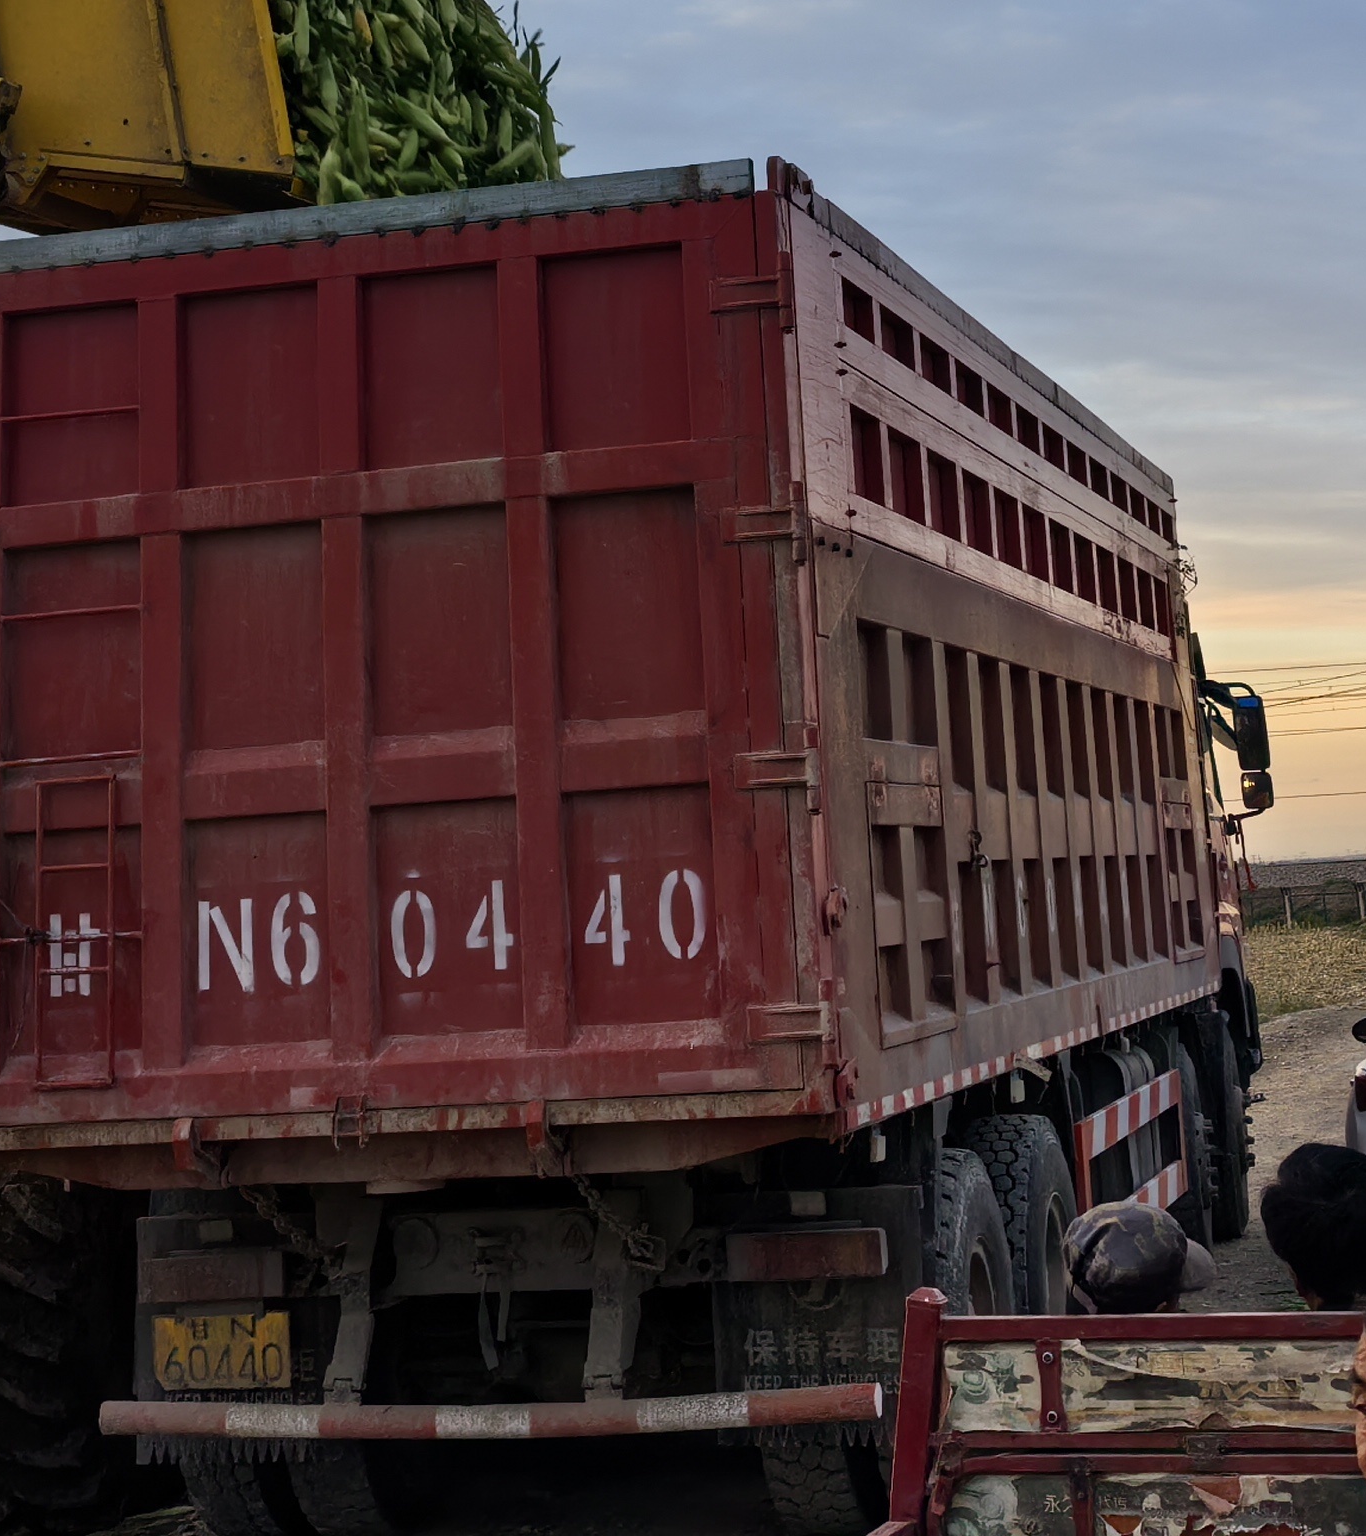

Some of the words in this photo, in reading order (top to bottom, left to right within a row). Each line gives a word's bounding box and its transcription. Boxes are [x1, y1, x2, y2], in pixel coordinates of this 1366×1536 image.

[163, 1342, 284, 1386] 60440
[743, 1327, 901, 1367] 保持车距
[743, 1374, 783, 1392] KEEP
[789, 1373, 821, 1389] THE
